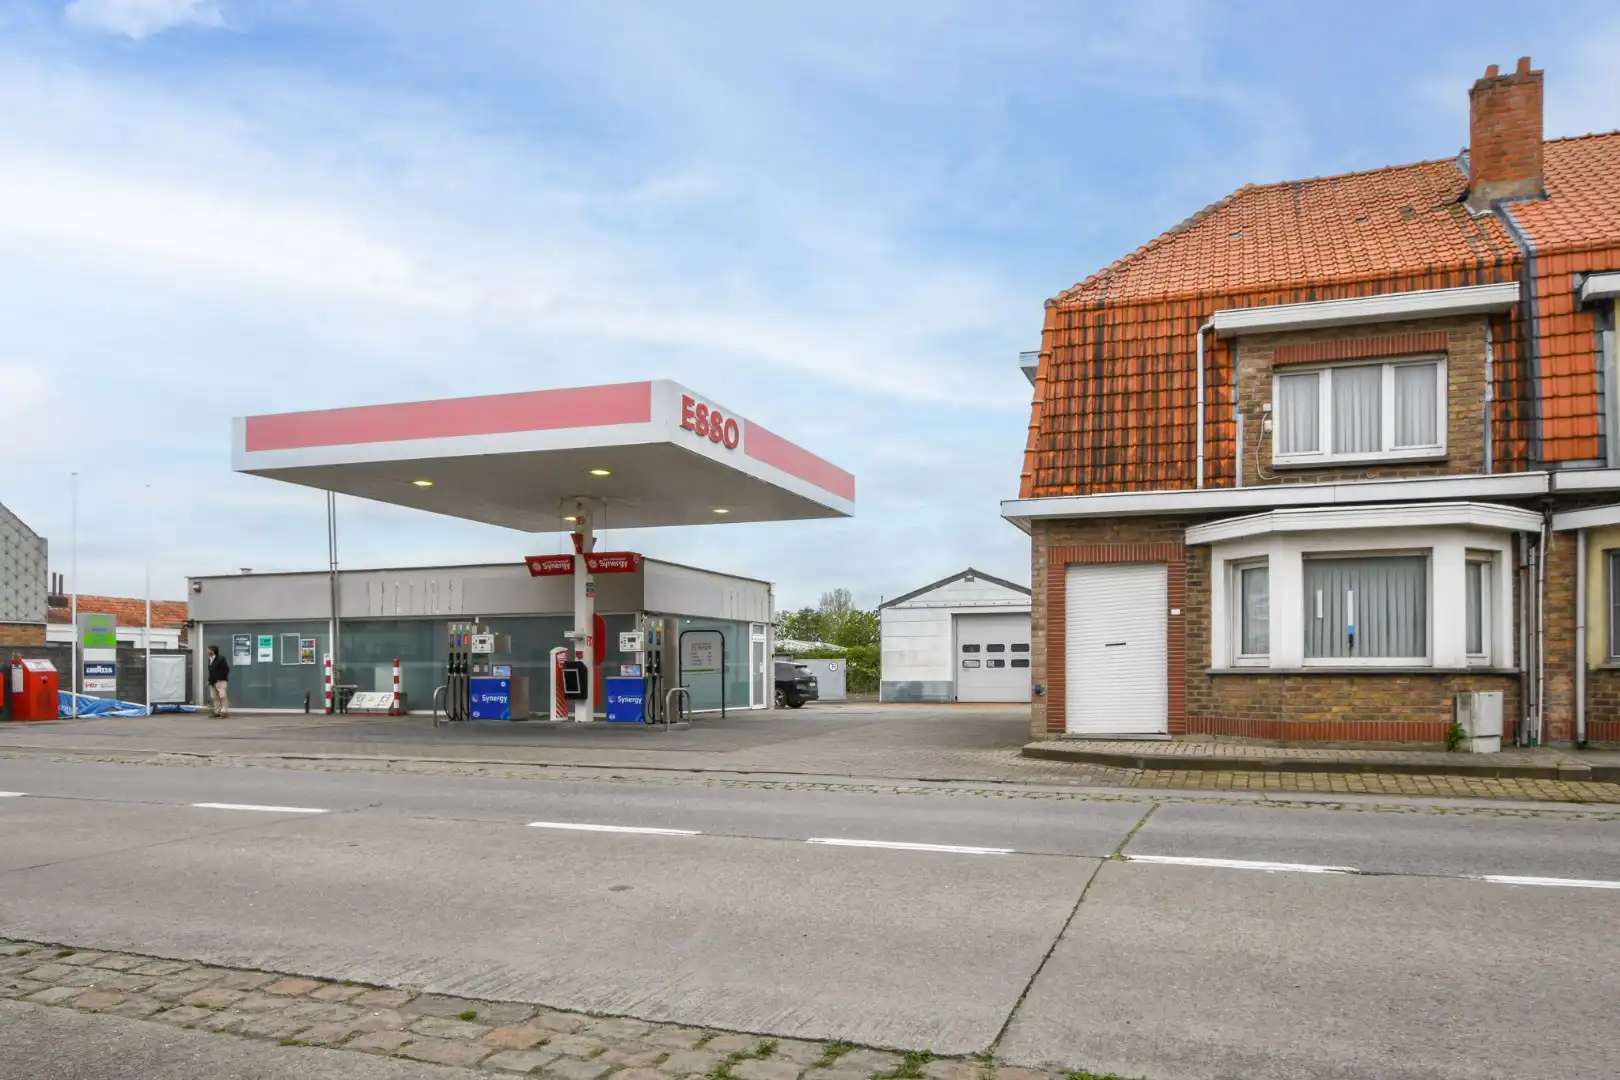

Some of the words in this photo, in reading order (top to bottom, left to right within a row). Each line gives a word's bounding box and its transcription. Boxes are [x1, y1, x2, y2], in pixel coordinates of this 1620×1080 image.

[681, 393, 740, 450] ESSO
[542, 562, 571, 570] Synergy
[599, 560, 628, 569] Synergy
[482, 694, 508, 703] Synergy
[617, 695, 643, 704] Synergy
